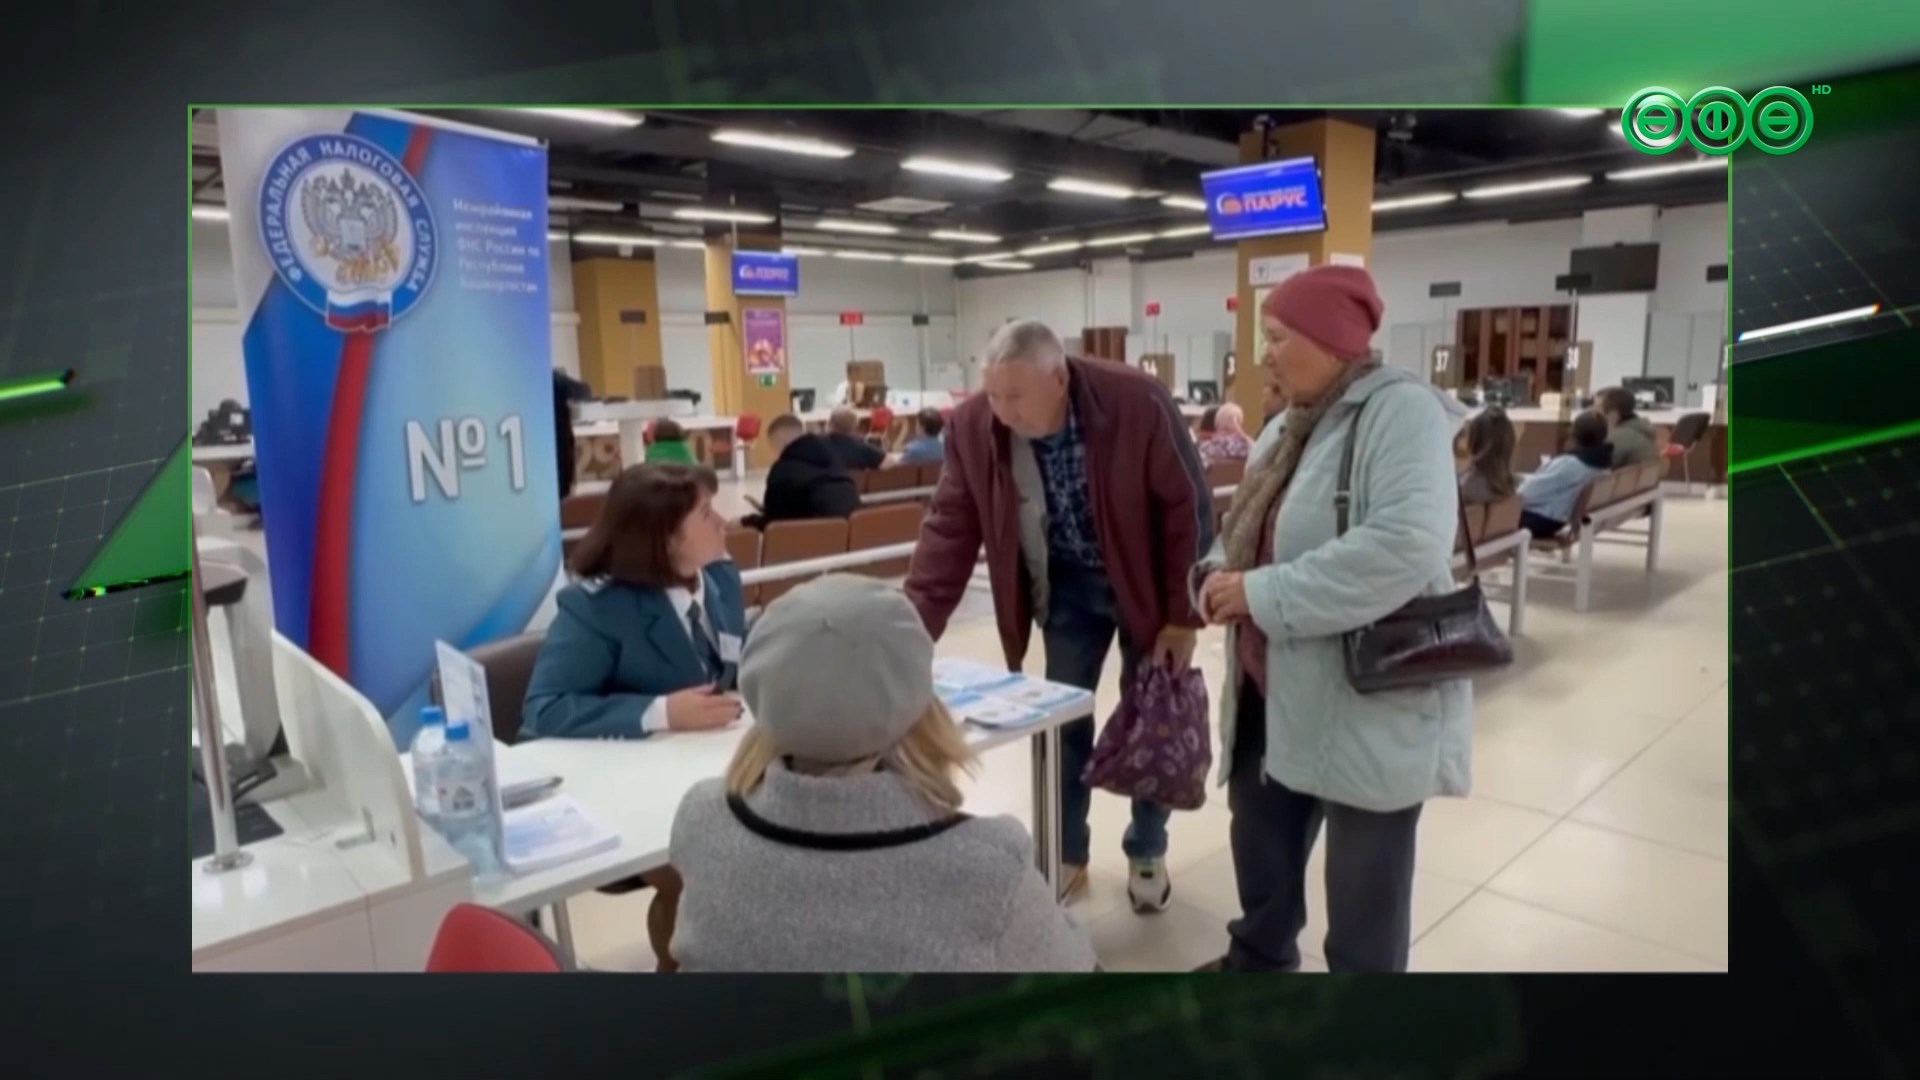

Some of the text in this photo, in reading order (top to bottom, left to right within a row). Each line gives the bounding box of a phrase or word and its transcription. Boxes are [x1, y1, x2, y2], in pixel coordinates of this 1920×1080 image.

[267, 140, 432, 292] ФЕДЕРАЛЬНАЯ НАЛОГОВАЯ СЛУЖБА
[1435, 350, 1449, 372] 37
